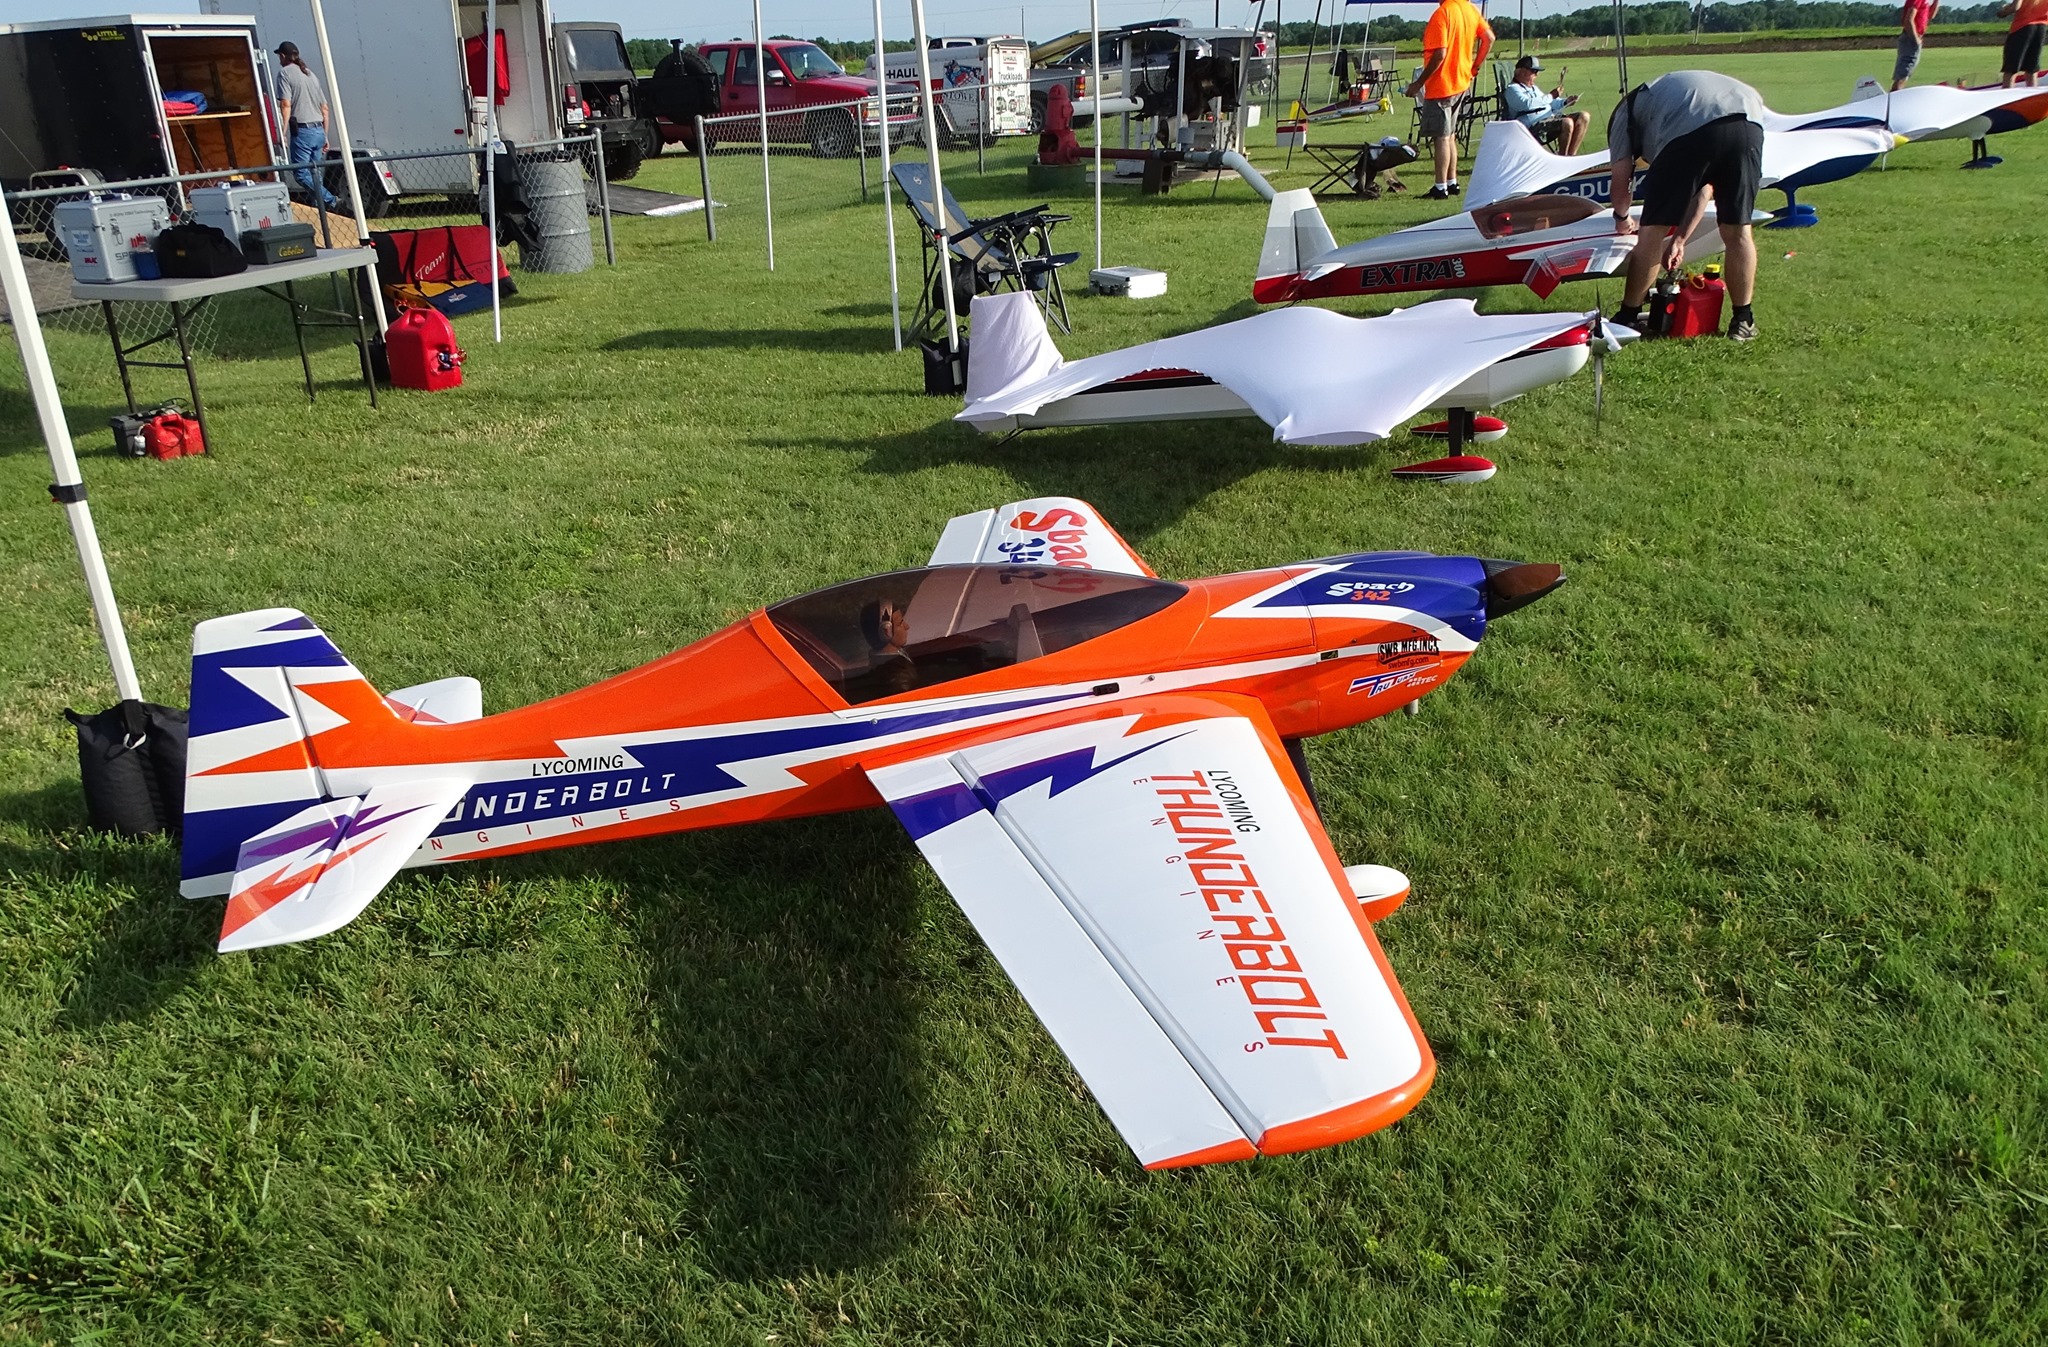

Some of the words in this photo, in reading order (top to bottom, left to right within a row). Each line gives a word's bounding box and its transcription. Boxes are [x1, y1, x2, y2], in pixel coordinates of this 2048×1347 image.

[886, 67, 919, 80] -HAUL
[415, 251, 446, 281] Team
[1360, 257, 1454, 289] EXTRA
[1451, 257, 1466, 279] 300
[1325, 581, 1416, 597] Sbach
[1350, 590, 1391, 601] 342
[1379, 640, 1399, 662] SWB
[1387, 655, 1430, 670] swbmfg.com
[531, 754, 625, 777] LYCOMING
[440, 773, 675, 824] UNDERBOLT
[1206, 770, 1262, 833] LYCOMING
[430, 799, 681, 851] NGINES
[1150, 769, 1349, 1060] THUNDERBOLT
